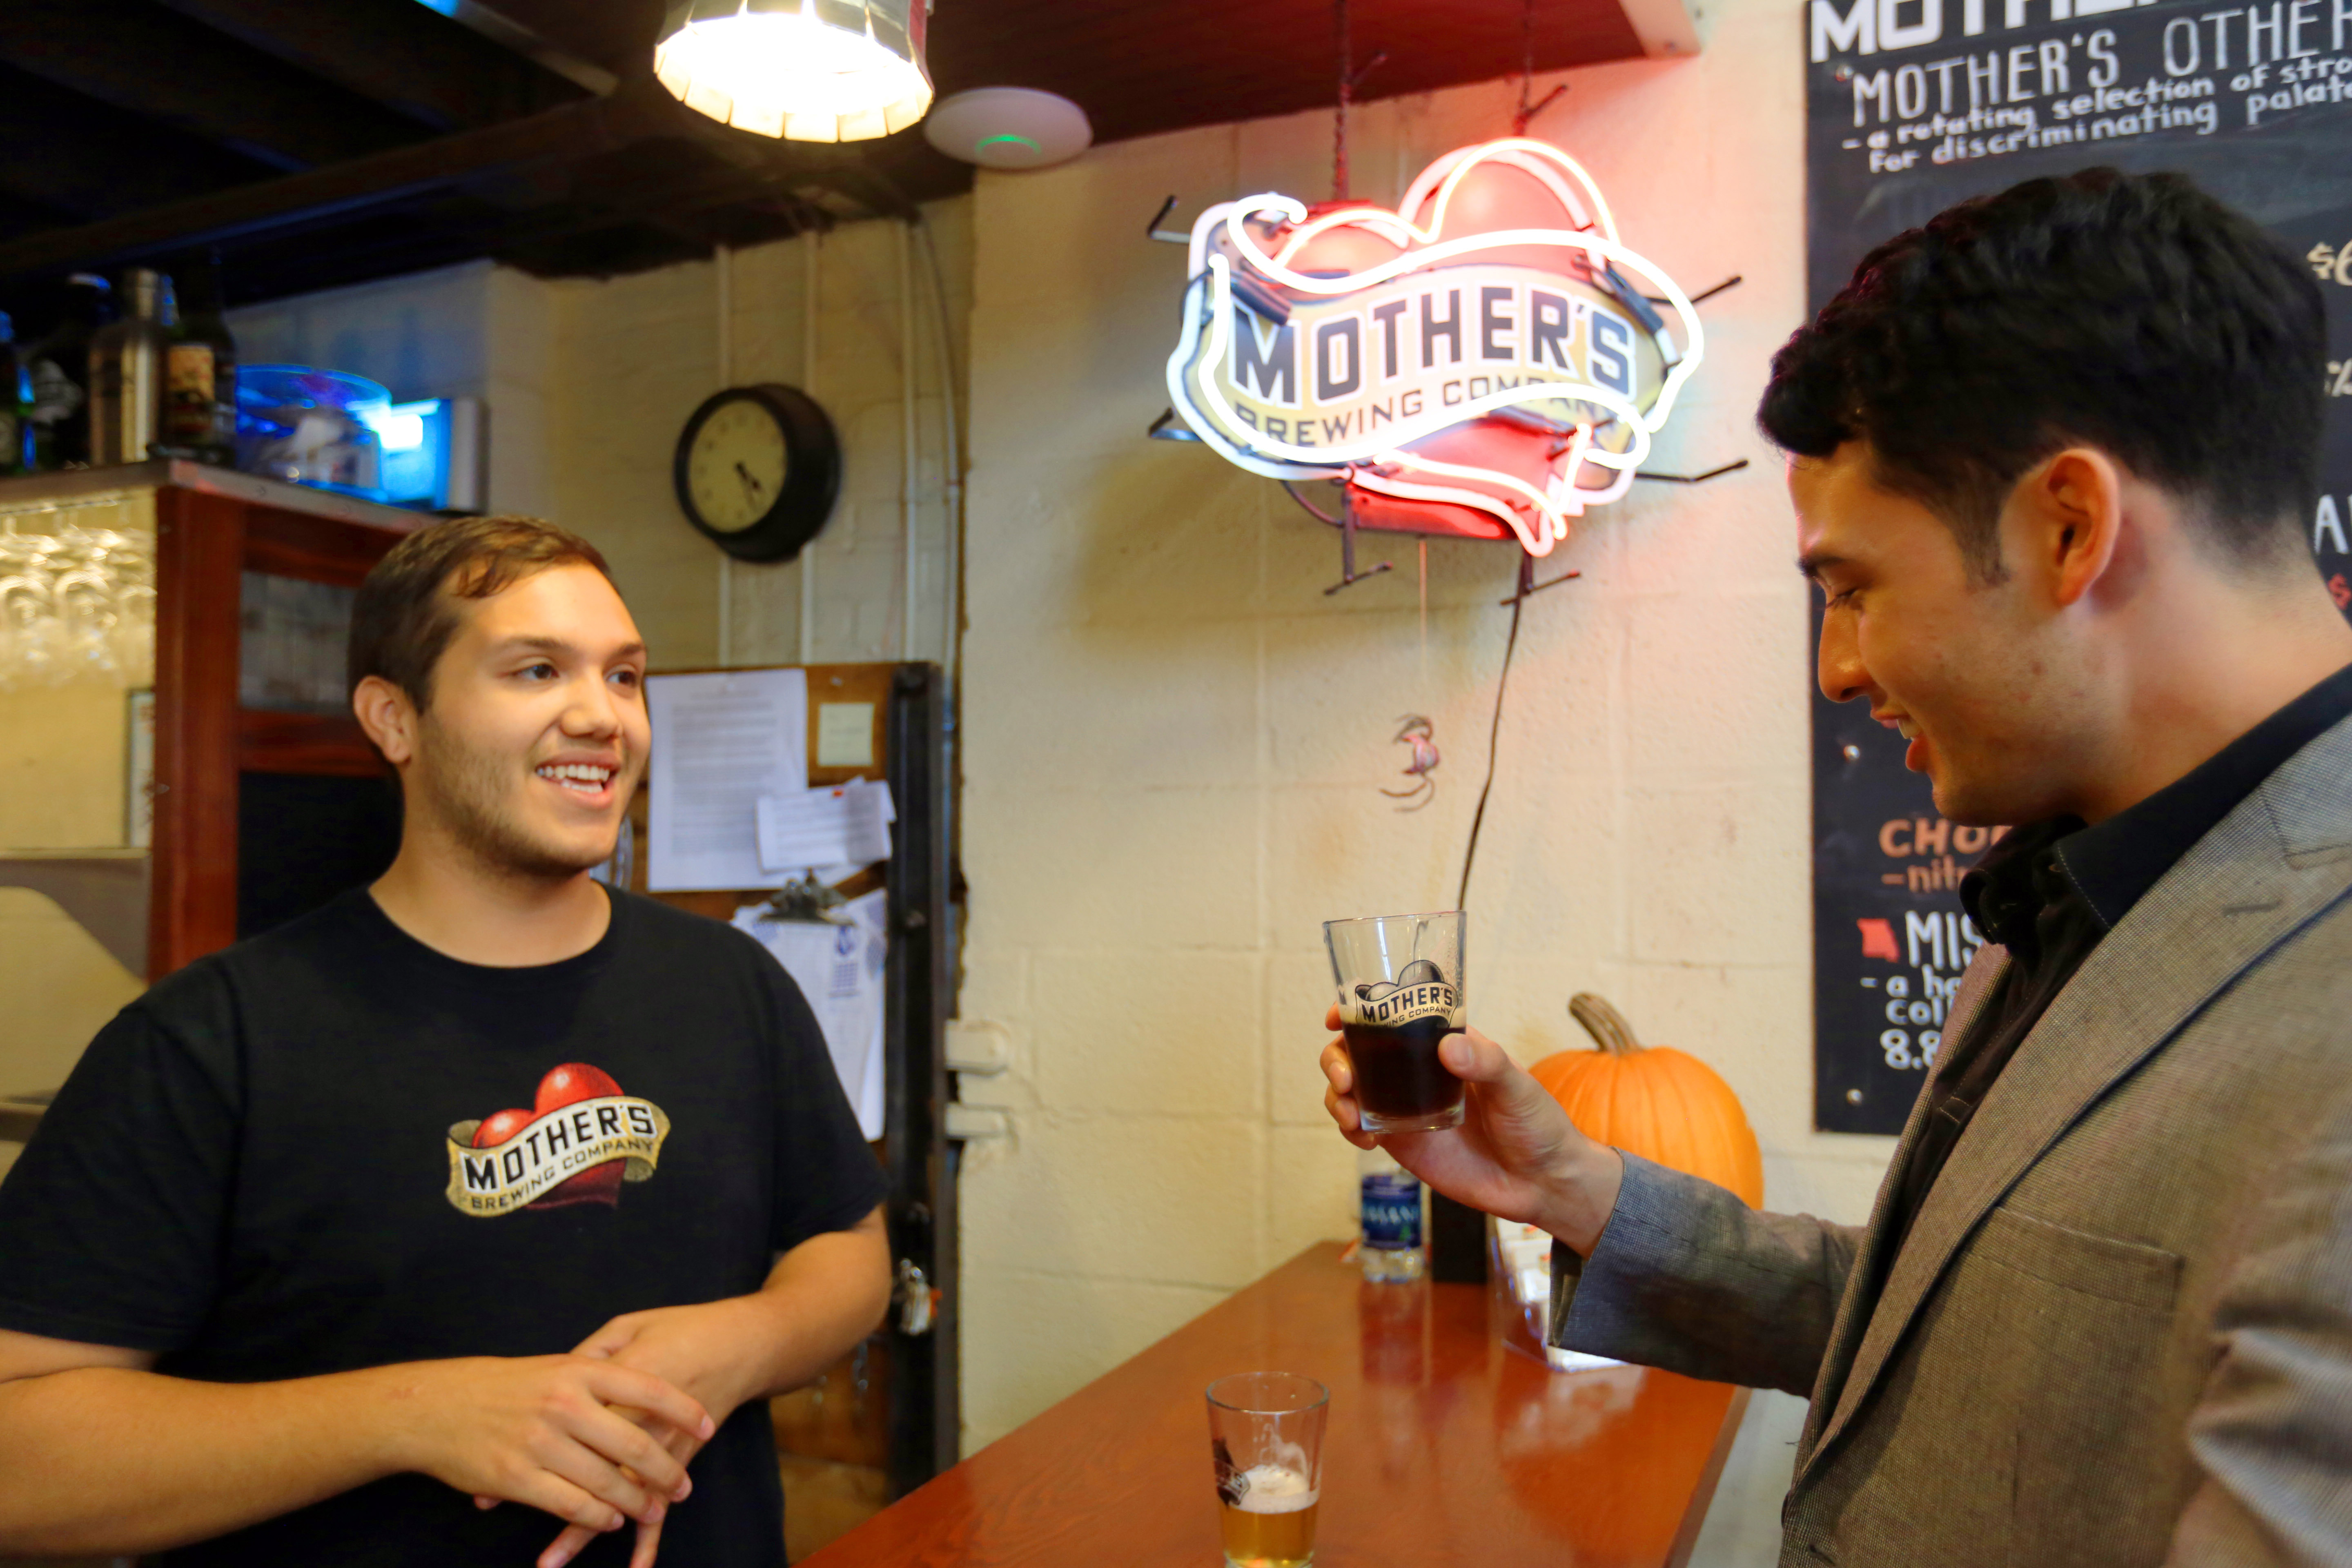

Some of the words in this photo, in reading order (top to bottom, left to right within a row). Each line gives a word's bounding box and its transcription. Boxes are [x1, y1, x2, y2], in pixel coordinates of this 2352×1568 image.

[1853, 28, 2120, 127] MOTHER'S
[1897, 106, 2038, 144] rotating
[2051, 77, 2215, 120] selection
[1931, 100, 2219, 165] discriminating
[1234, 285, 1629, 404] MOTHER'S
[1235, 389, 1422, 447] BREWING
[1442, 374, 1613, 421] COMAN
[2314, 494, 2352, 555] A
[1361, 987, 1452, 1023] MOTHER'S
[1409, 1007, 1451, 1017] COMPANY
[464, 1105, 654, 1190] MOTHER'S
[471, 1165, 555, 1209] BREWING
[563, 1140, 653, 1170] COMPANY
